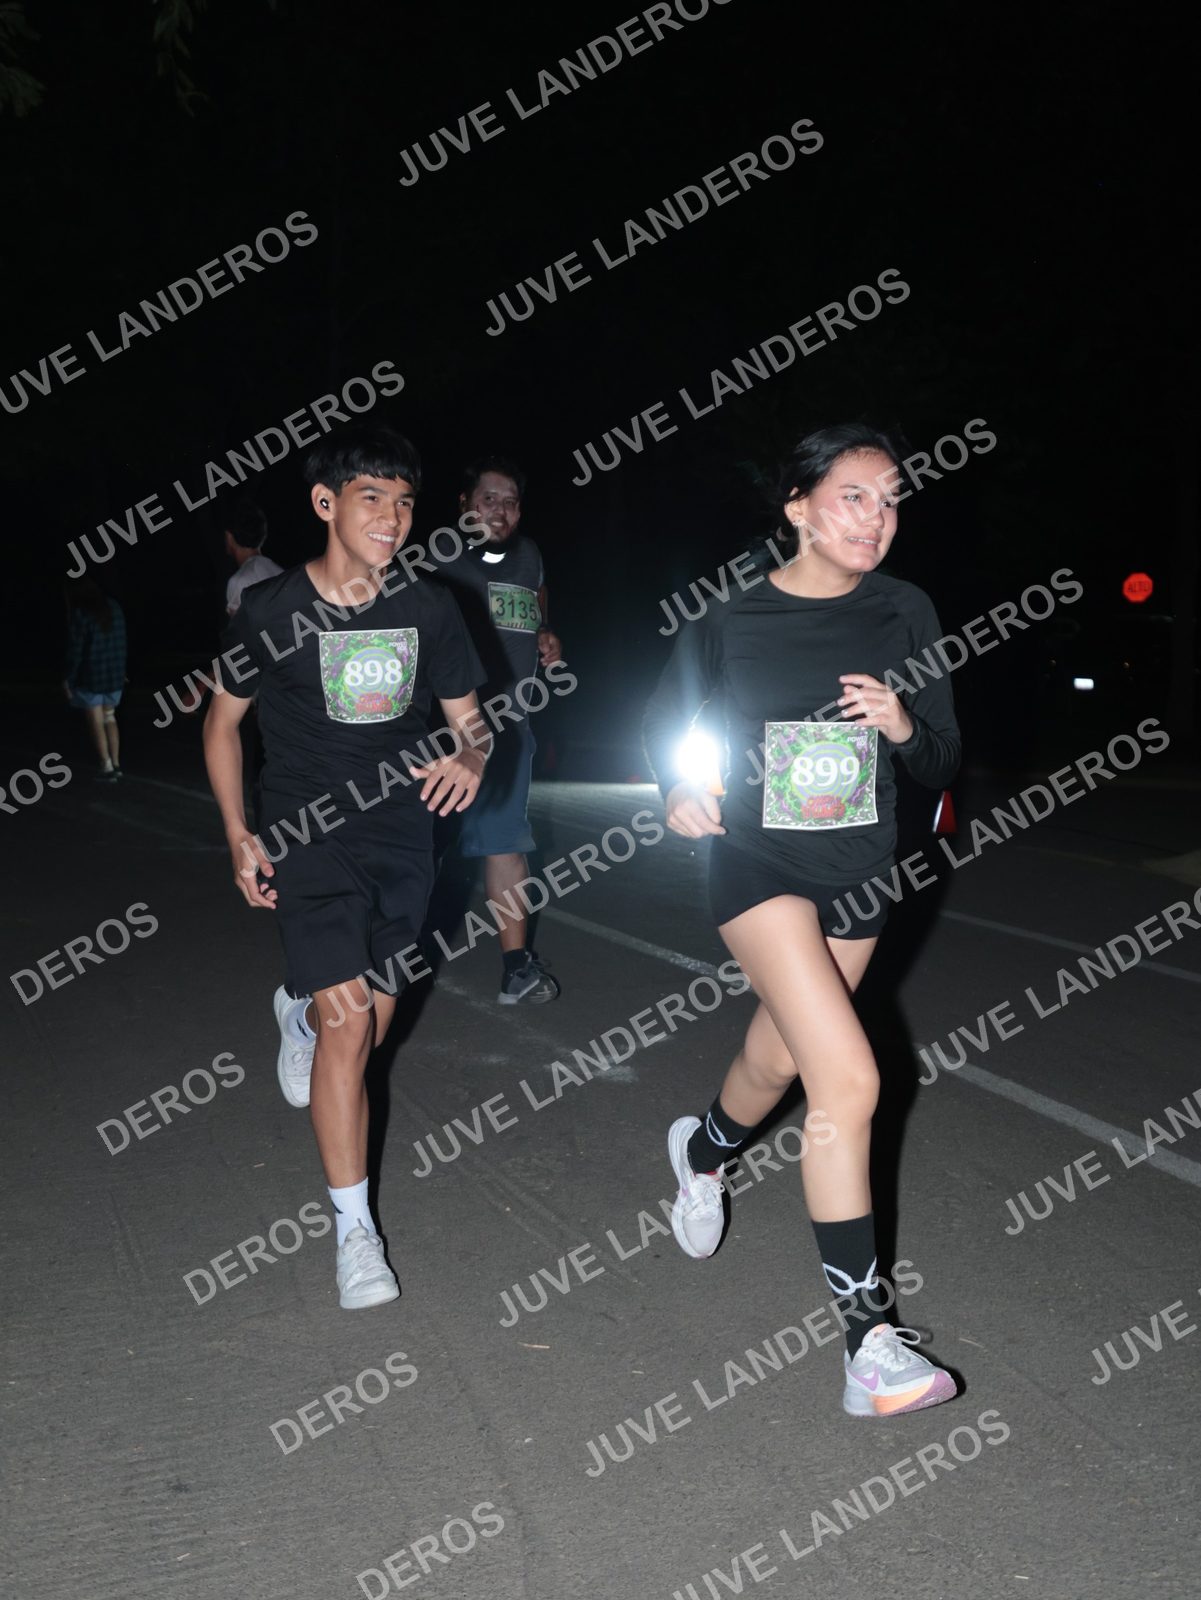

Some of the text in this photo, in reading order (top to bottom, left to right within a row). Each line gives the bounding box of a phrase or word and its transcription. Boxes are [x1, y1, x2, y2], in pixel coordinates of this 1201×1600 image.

[495, 597, 537, 621] 3135
[344, 659, 403, 687] 898
[790, 756, 860, 787] 899
